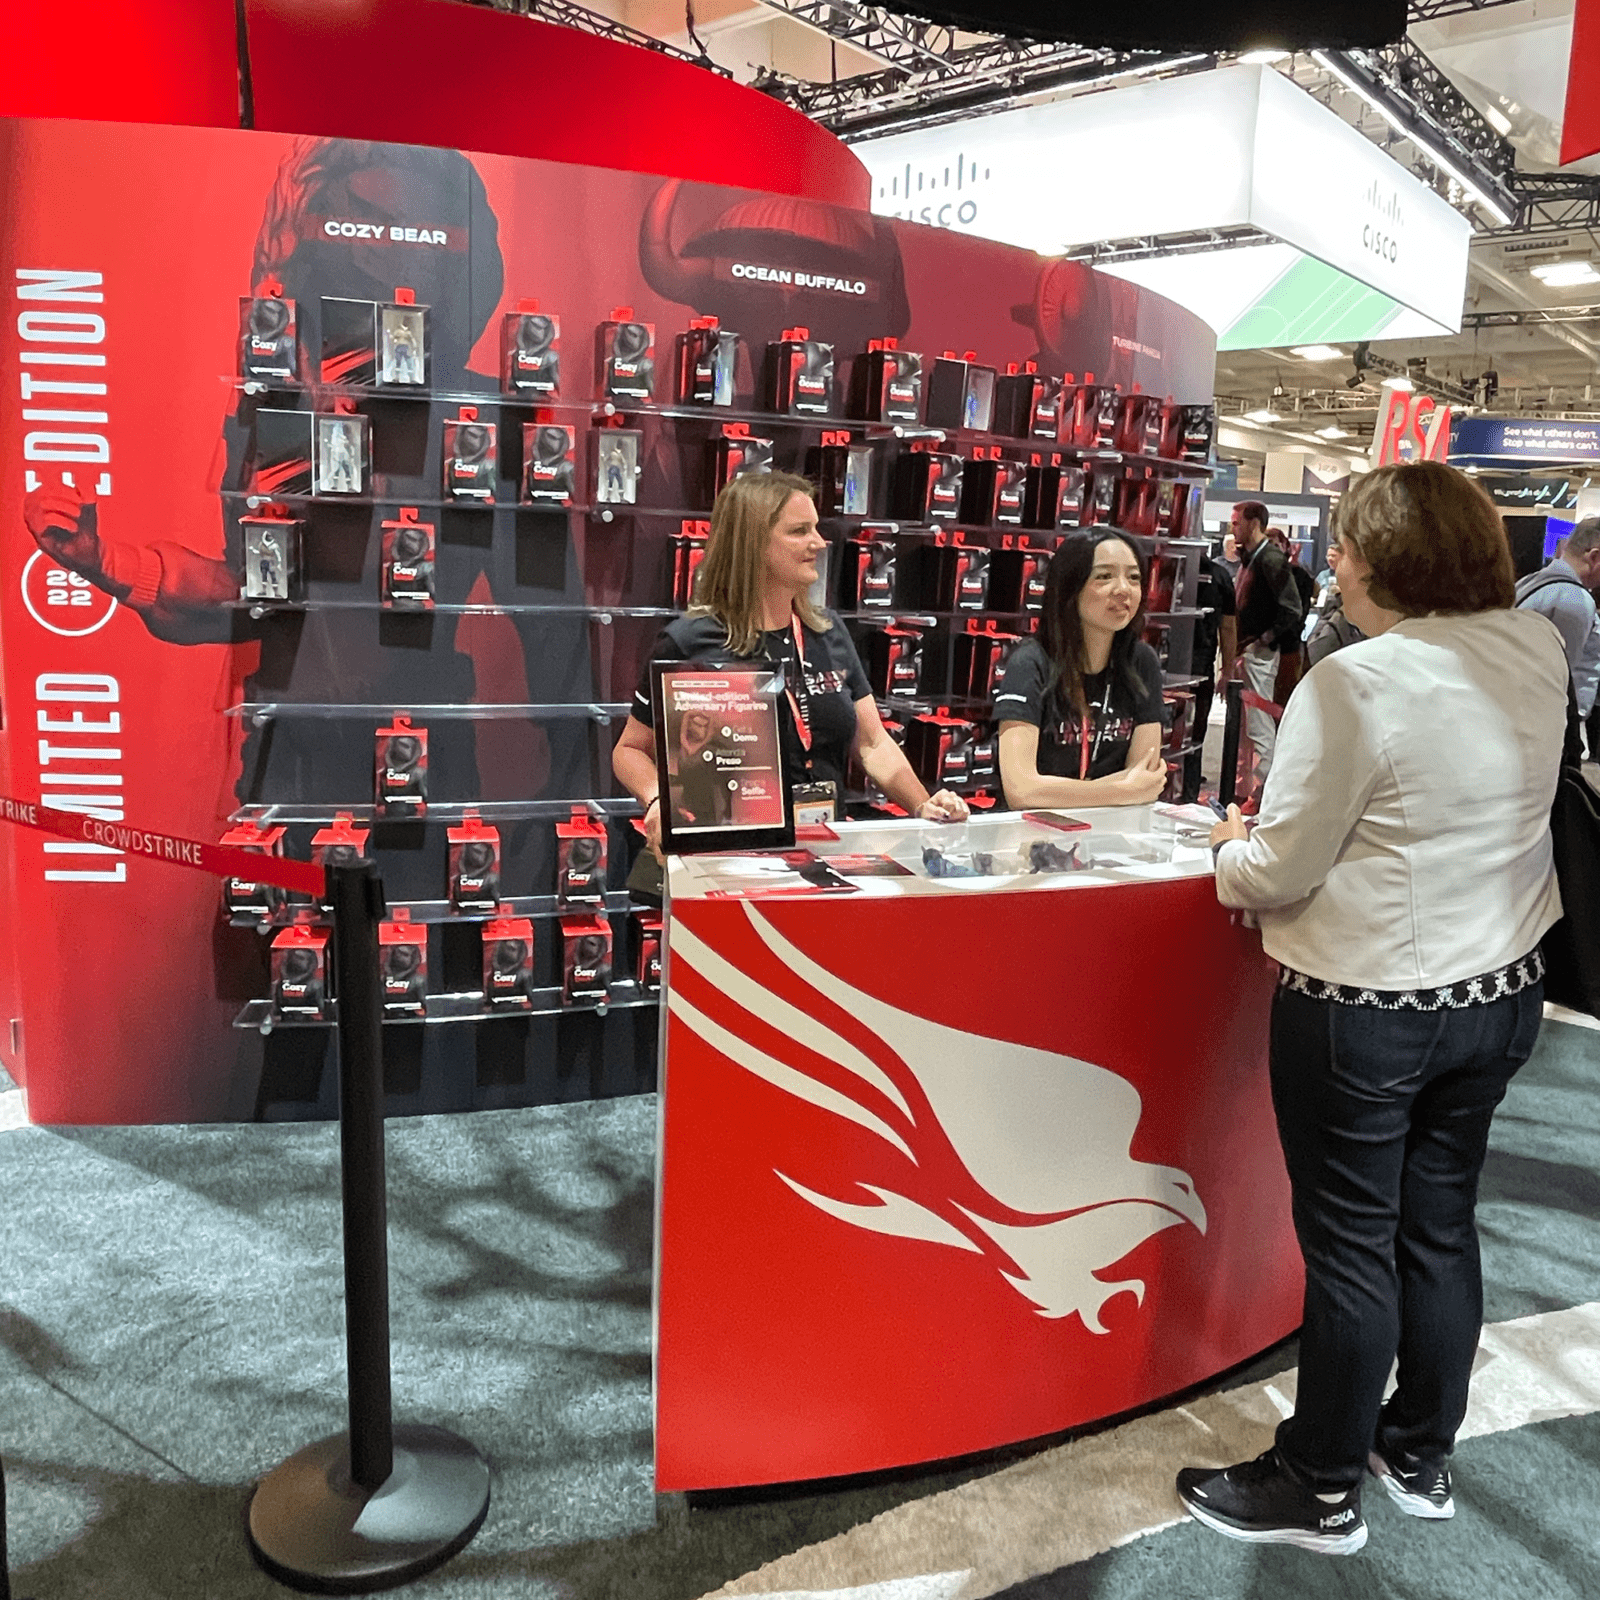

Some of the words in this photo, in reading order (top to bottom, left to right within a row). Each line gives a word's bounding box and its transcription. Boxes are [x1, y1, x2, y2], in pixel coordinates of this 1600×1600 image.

[892, 200, 977, 226] ISCO
[324, 221, 385, 239] COZY
[389, 226, 447, 245] BEAR
[1363, 224, 1397, 263] CISCO
[731, 263, 791, 284] OCEAN
[795, 272, 866, 295] BUFFALO
[251, 339, 277, 351] Cozy
[518, 354, 542, 367] Cozy
[614, 362, 638, 374] Cozy
[1504, 427, 1520, 435] See
[1522, 428, 1543, 437] what
[1544, 428, 1572, 438] others
[1503, 438, 1523, 448] Stop
[1525, 440, 1546, 448] what
[1547, 440, 1575, 449] others
[454, 463, 479, 475] Cozy
[533, 465, 557, 477] Cozy
[392, 564, 418, 577] Cozy
[47, 589, 92, 606] 22
[732, 733, 758, 742] Demo
[386, 771, 409, 783] Cozy
[83, 820, 203, 865] CROWDSTRIKE
[460, 876, 484, 888] Cozy
[568, 871, 591, 882] Cozy
[231, 880, 256, 892] Cozy
[493, 972, 517, 984] Cozy
[574, 967, 597, 978] Cozy
[282, 982, 307, 994] Cozy
[386, 978, 410, 990] Cozy
[1319, 1508, 1355, 1529] HOKA
